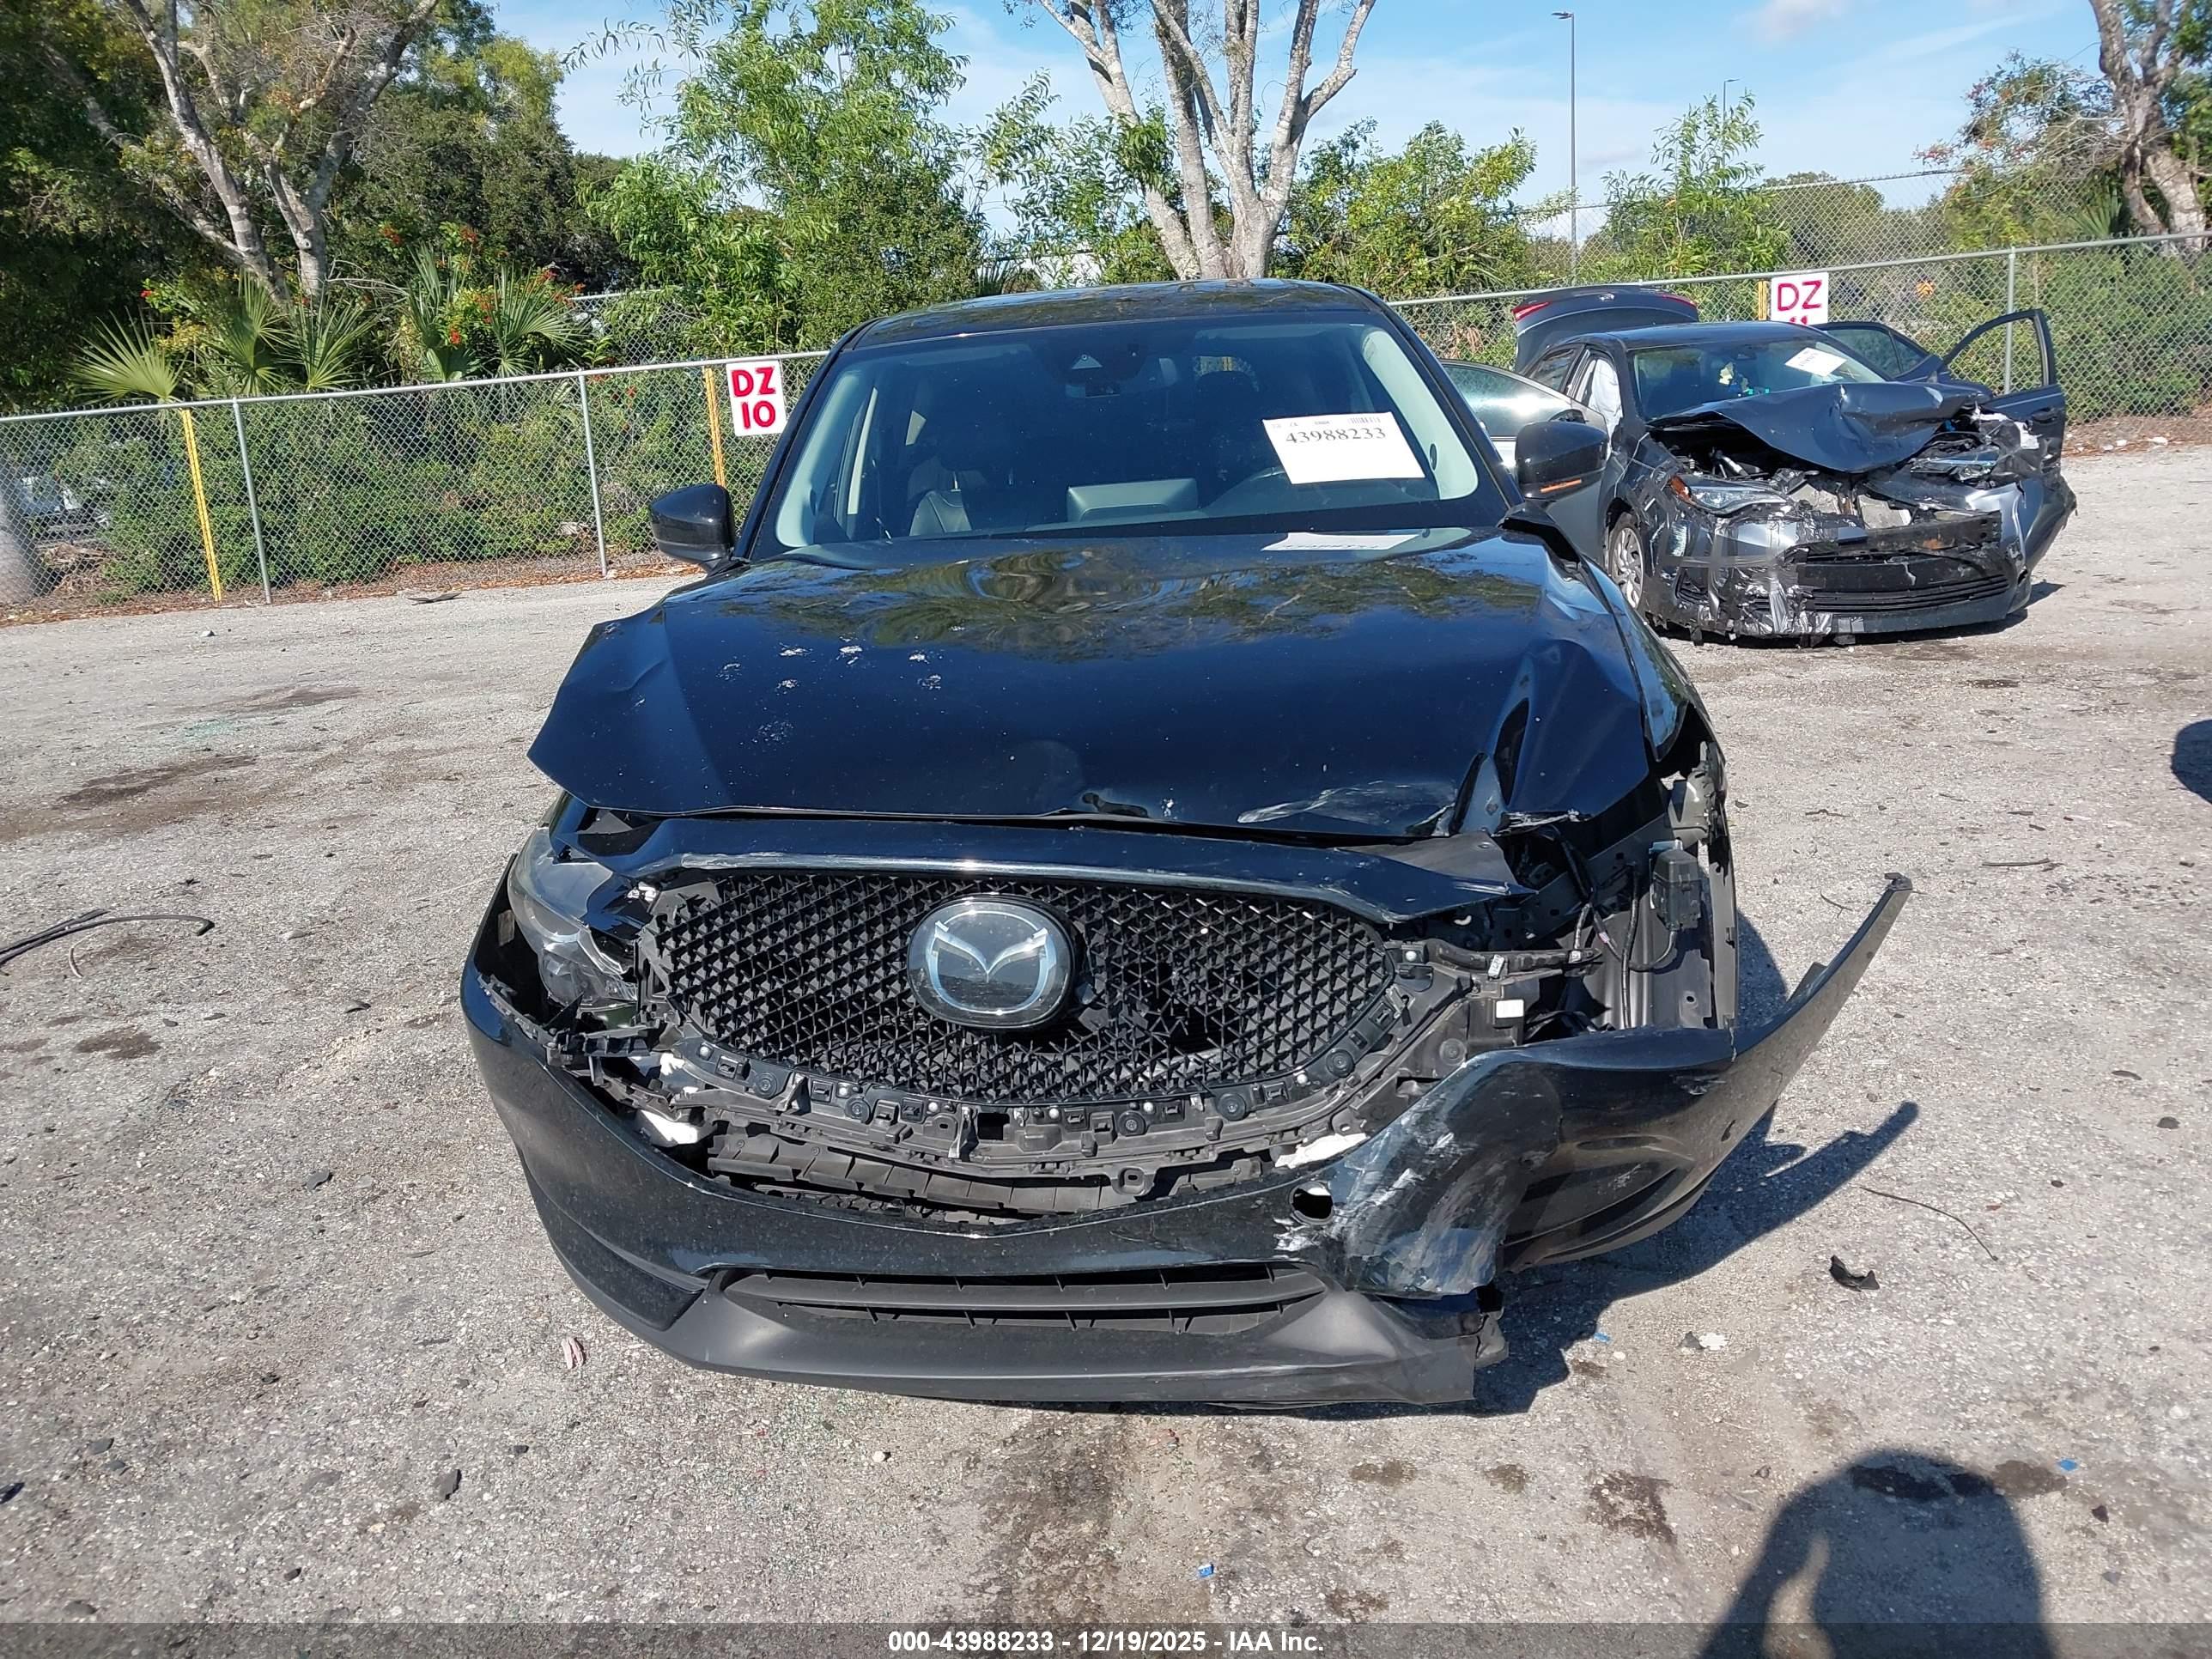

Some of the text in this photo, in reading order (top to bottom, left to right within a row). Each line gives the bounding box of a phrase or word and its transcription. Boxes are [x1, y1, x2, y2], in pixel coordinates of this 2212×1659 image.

[1778, 280, 1822, 311] DZ
[731, 366, 776, 398] DZ
[740, 400, 776, 429] 10
[1285, 427, 1387, 444] 43988233
